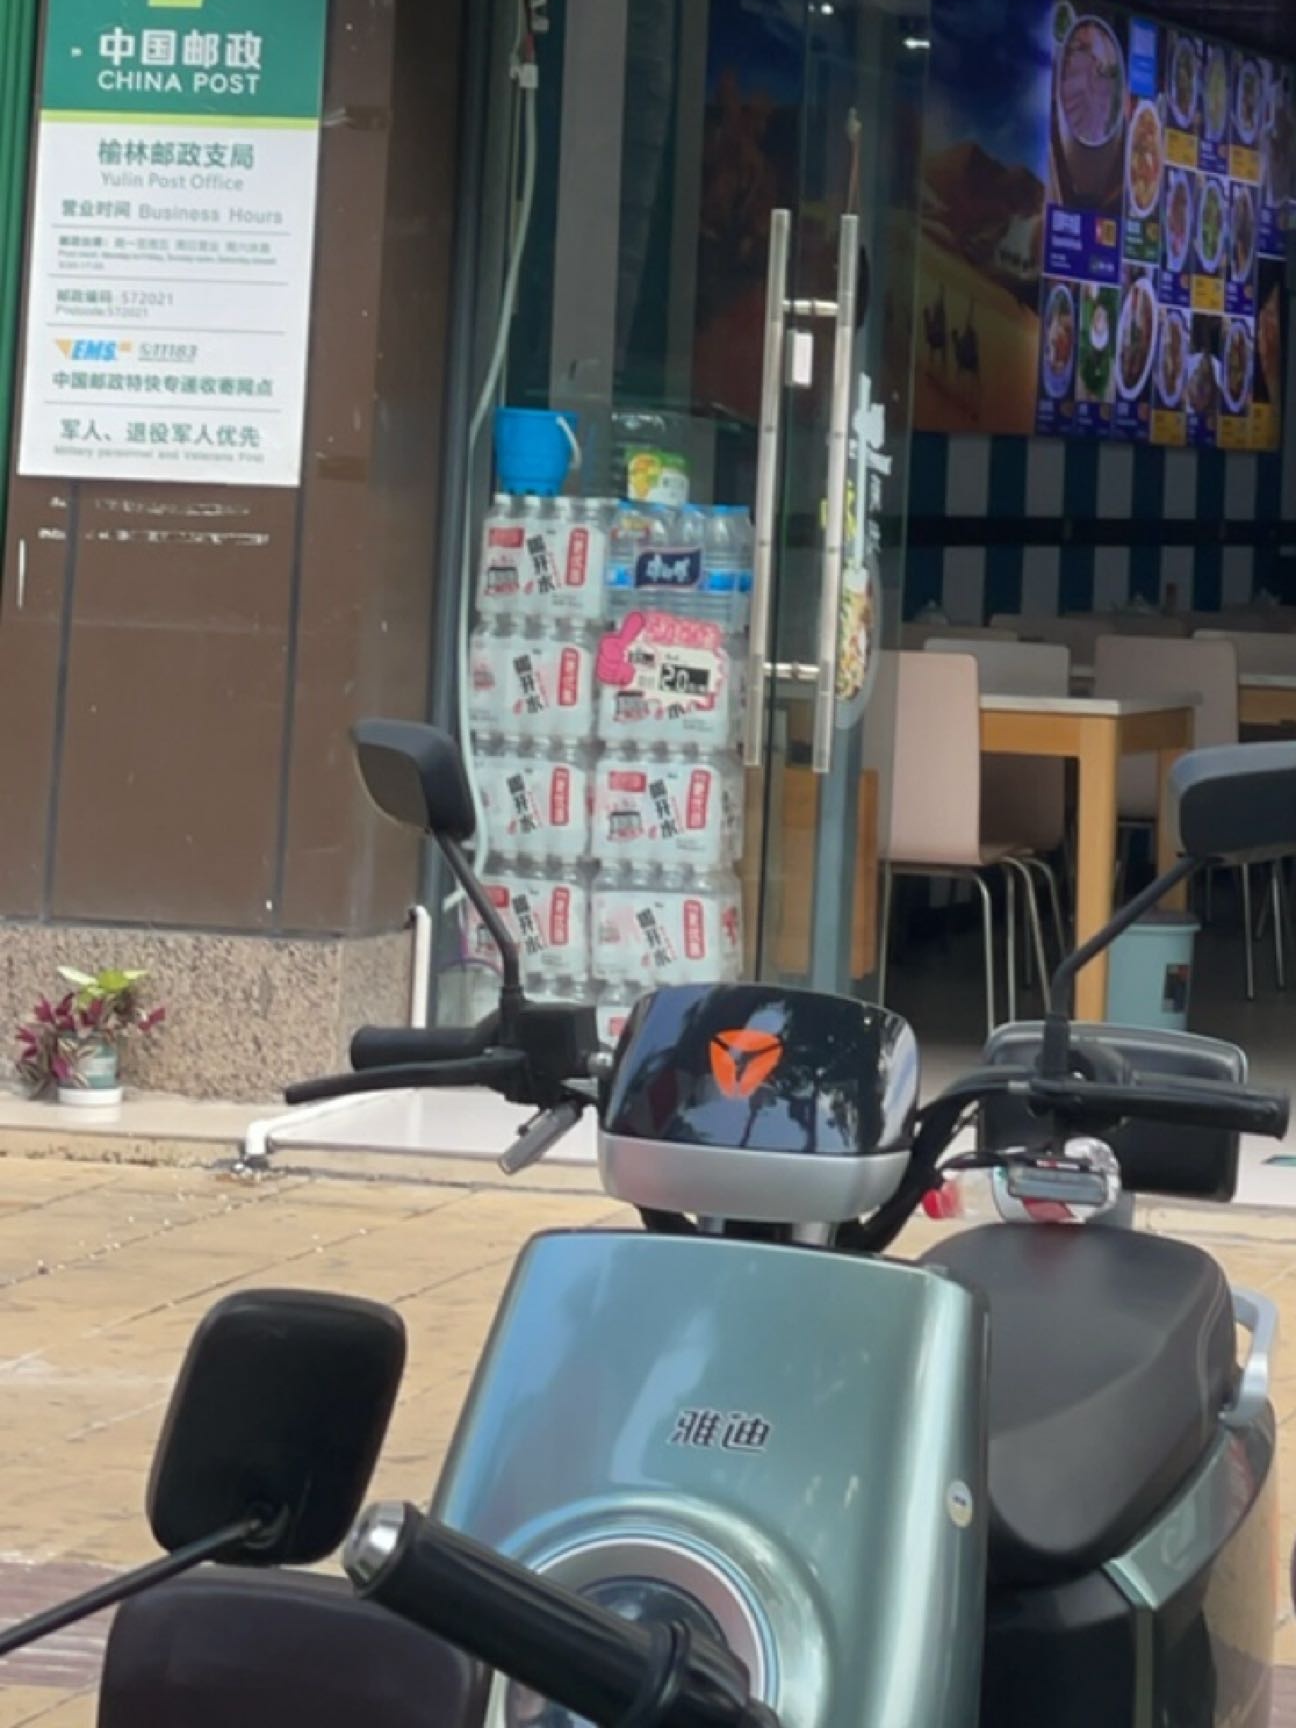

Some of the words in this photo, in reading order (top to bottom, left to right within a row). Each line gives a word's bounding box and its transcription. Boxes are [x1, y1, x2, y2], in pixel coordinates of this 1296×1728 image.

[99, 27, 262, 71] 中国邮政
[97, 70, 182, 93] CHINA
[193, 72, 261, 95] POST
[98, 138, 255, 170] 榆林邮政支局
[101, 171, 144, 189] Yulin
[149, 173, 186, 190] Post
[190, 174, 245, 192] Office
[138, 203, 220, 223] Business
[229, 207, 284, 225] Hours
[71, 339, 117, 361] EMS
[669, 1409, 771, 1453] 雅迪
